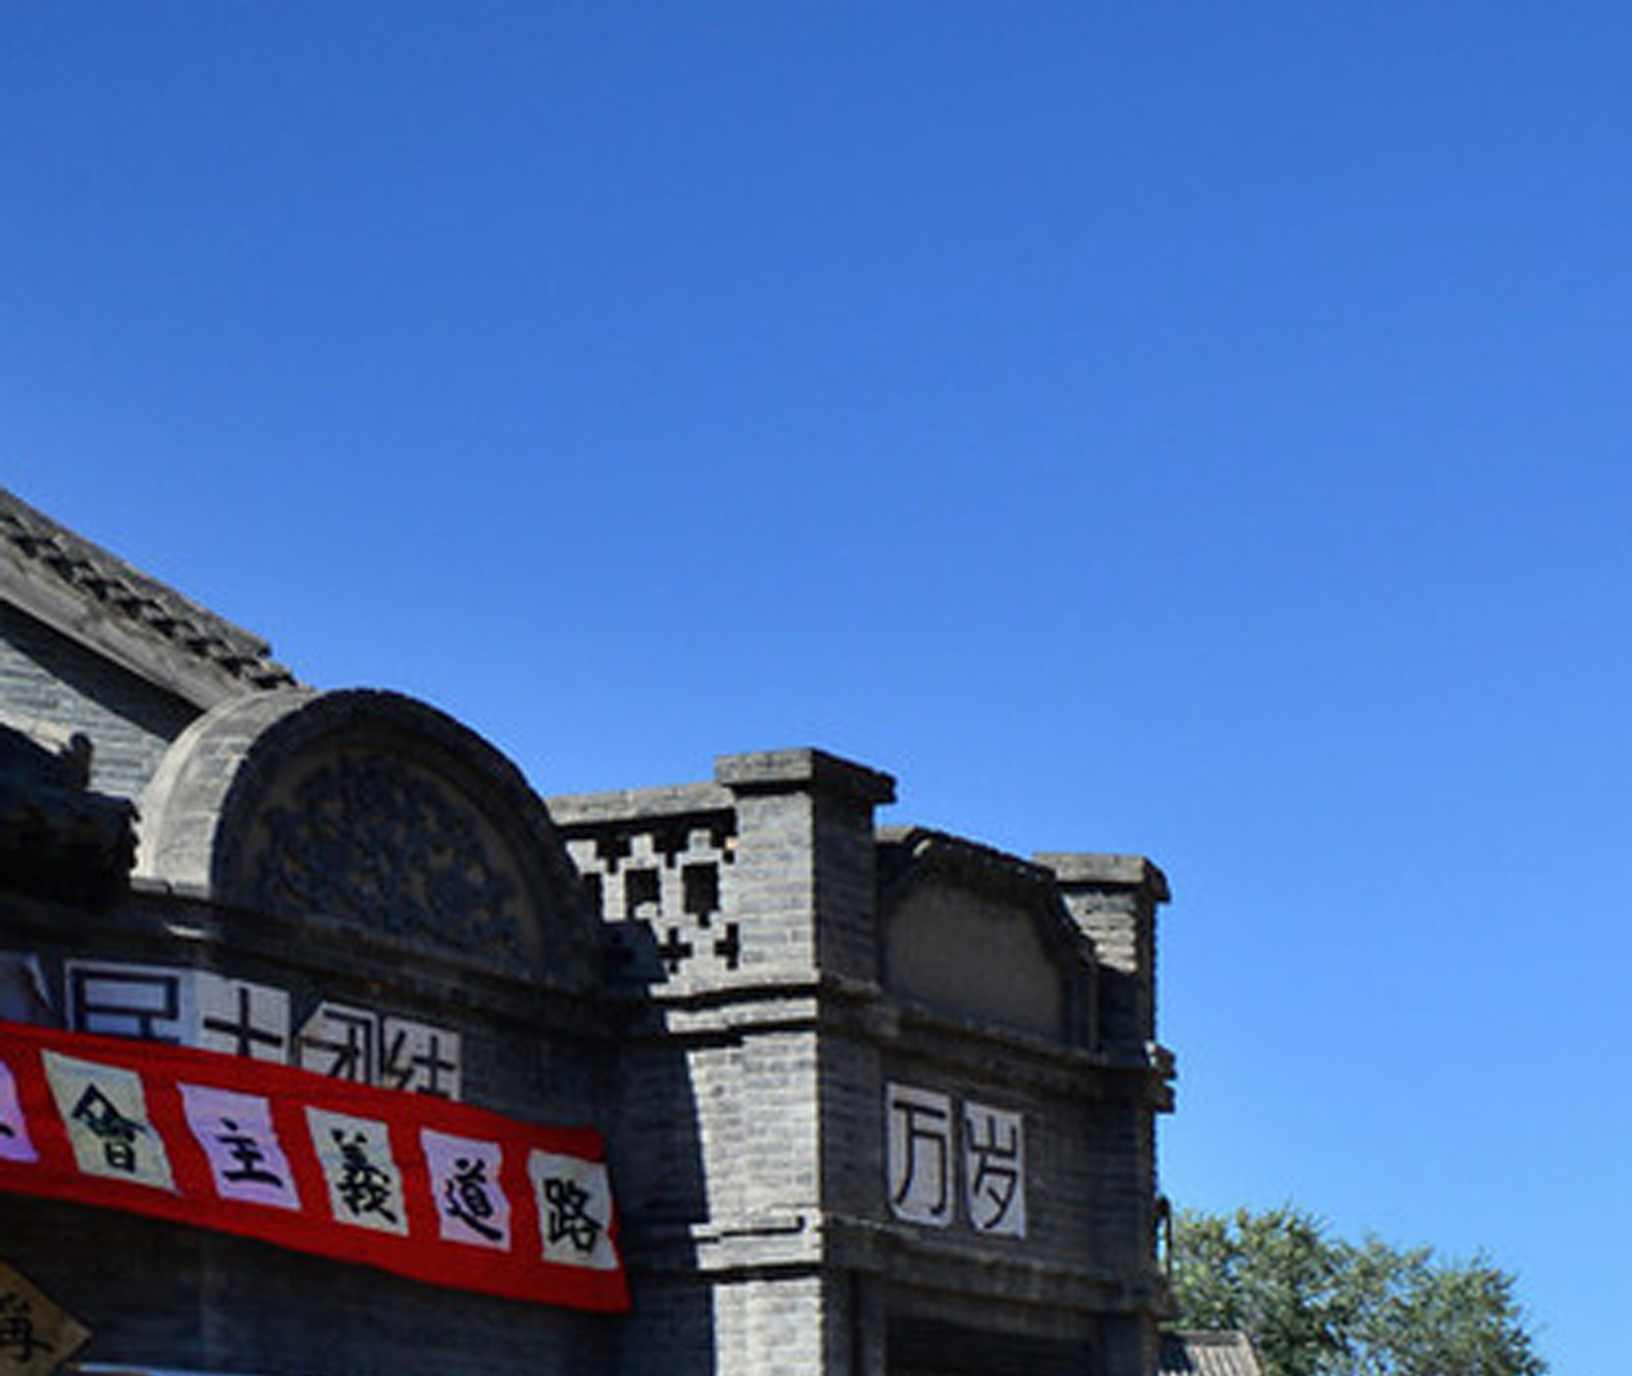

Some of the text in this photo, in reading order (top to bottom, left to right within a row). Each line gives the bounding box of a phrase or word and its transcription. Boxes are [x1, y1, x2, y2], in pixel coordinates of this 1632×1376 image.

[0, 1083, 602, 1253] 會主義道路
[893, 1101, 1017, 1228] 万岁
